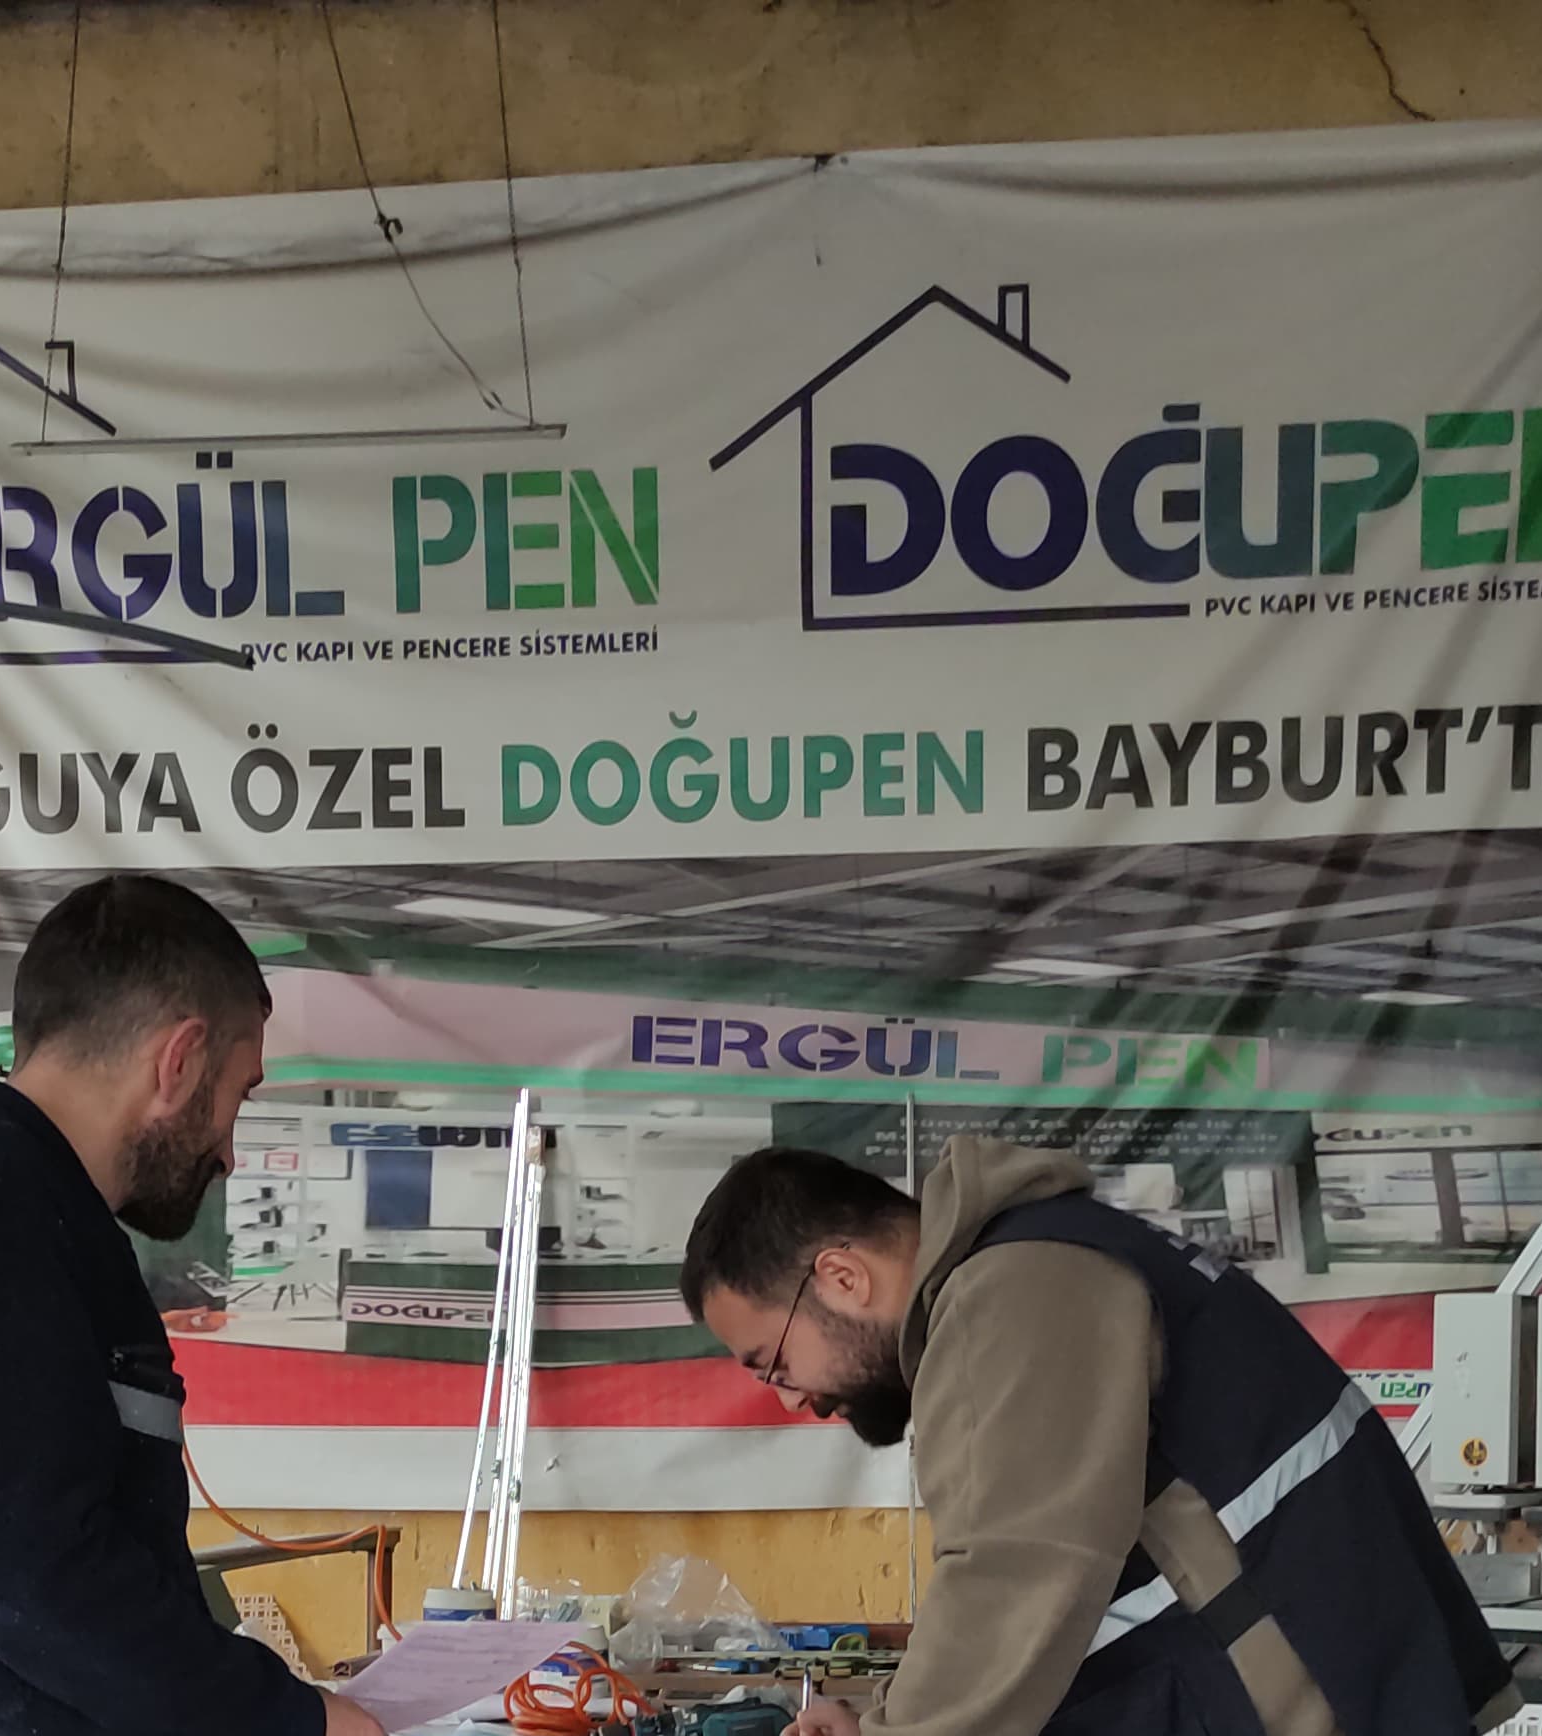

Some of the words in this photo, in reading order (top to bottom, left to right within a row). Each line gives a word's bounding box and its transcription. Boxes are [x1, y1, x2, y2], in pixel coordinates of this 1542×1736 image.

[391, 467, 659, 615] PEN
[1204, 596, 1252, 617] PVC
[1260, 593, 1316, 614] KAPI
[1324, 591, 1355, 611] VE
[1363, 582, 1470, 610] PENCERE
[296, 640, 354, 661] KAPI
[363, 639, 394, 661] VE
[402, 635, 511, 660] PENCERE
[519, 624, 659, 656] SİSTEMLERİ
[230, 723, 466, 833] ÖZEL
[499, 709, 985, 827] DOĞUPEN
[632, 1015, 1000, 1080] ERGÜL
[1041, 1034, 1260, 1087] PEN
